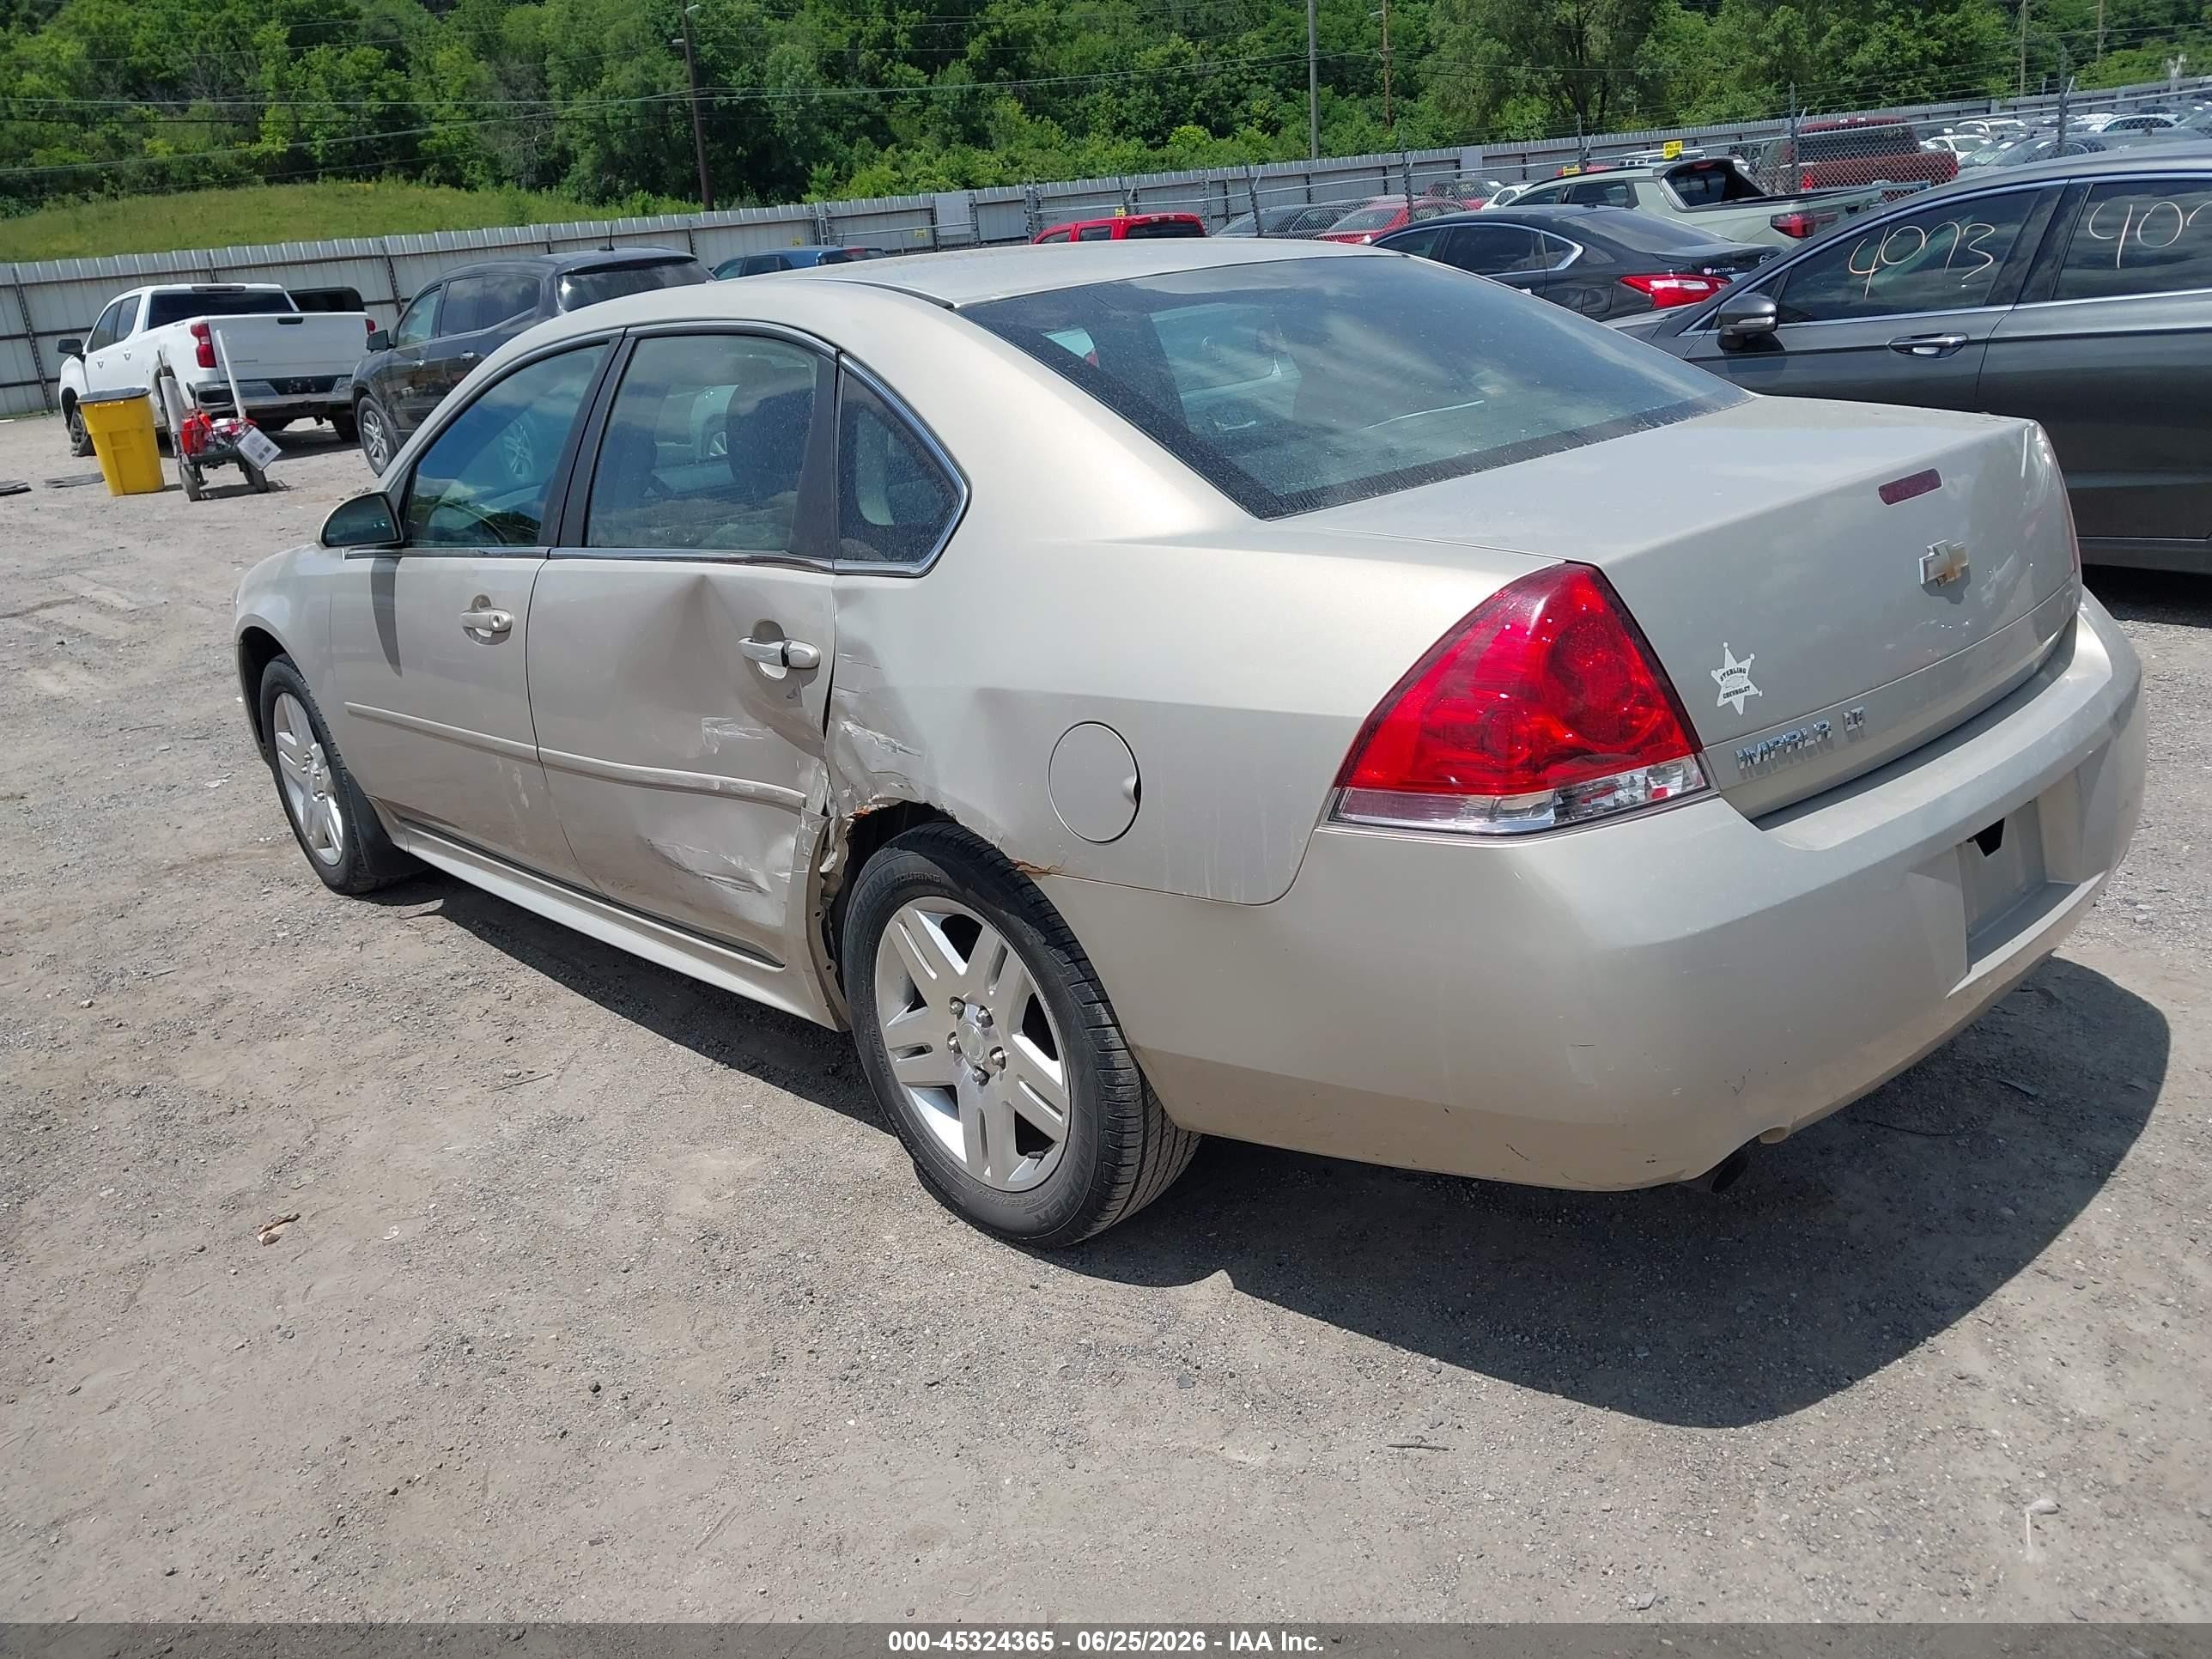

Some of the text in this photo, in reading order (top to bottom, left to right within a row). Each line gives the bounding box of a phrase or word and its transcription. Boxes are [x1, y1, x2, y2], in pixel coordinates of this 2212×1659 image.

[1719, 666, 1747, 682] STERLING
[1723, 684, 1751, 700] CHEVROLET
[1735, 705, 1867, 770] IMPALA LT
